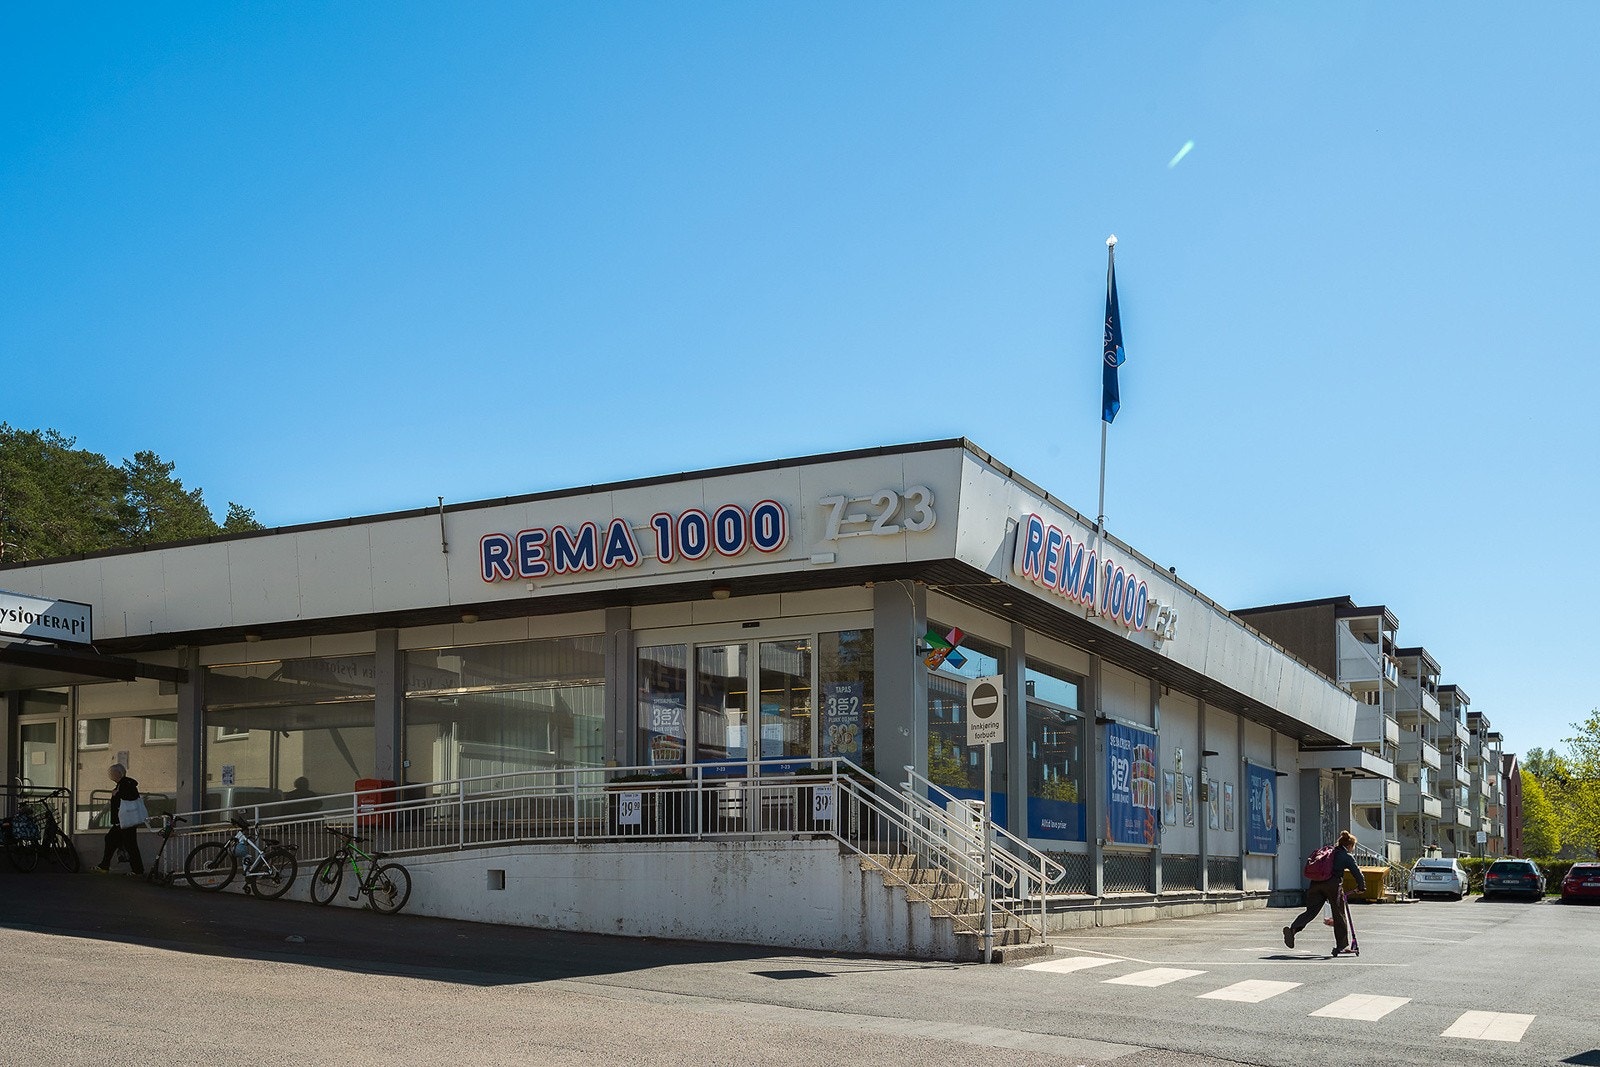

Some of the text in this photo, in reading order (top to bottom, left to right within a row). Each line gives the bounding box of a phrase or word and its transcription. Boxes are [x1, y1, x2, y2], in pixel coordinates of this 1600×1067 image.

[818, 485, 937, 541] 7-23
[480, 499, 789, 584] REMA 1000
[1022, 513, 1149, 633] REMA 1000
[835, 685, 852, 694] TAPAS
[828, 696, 859, 717] 3 FOR 2
[652, 707, 680, 727] 3 FOR 2
[970, 721, 1000, 733] Innkjøring
[974, 731, 996, 740] forbudt
